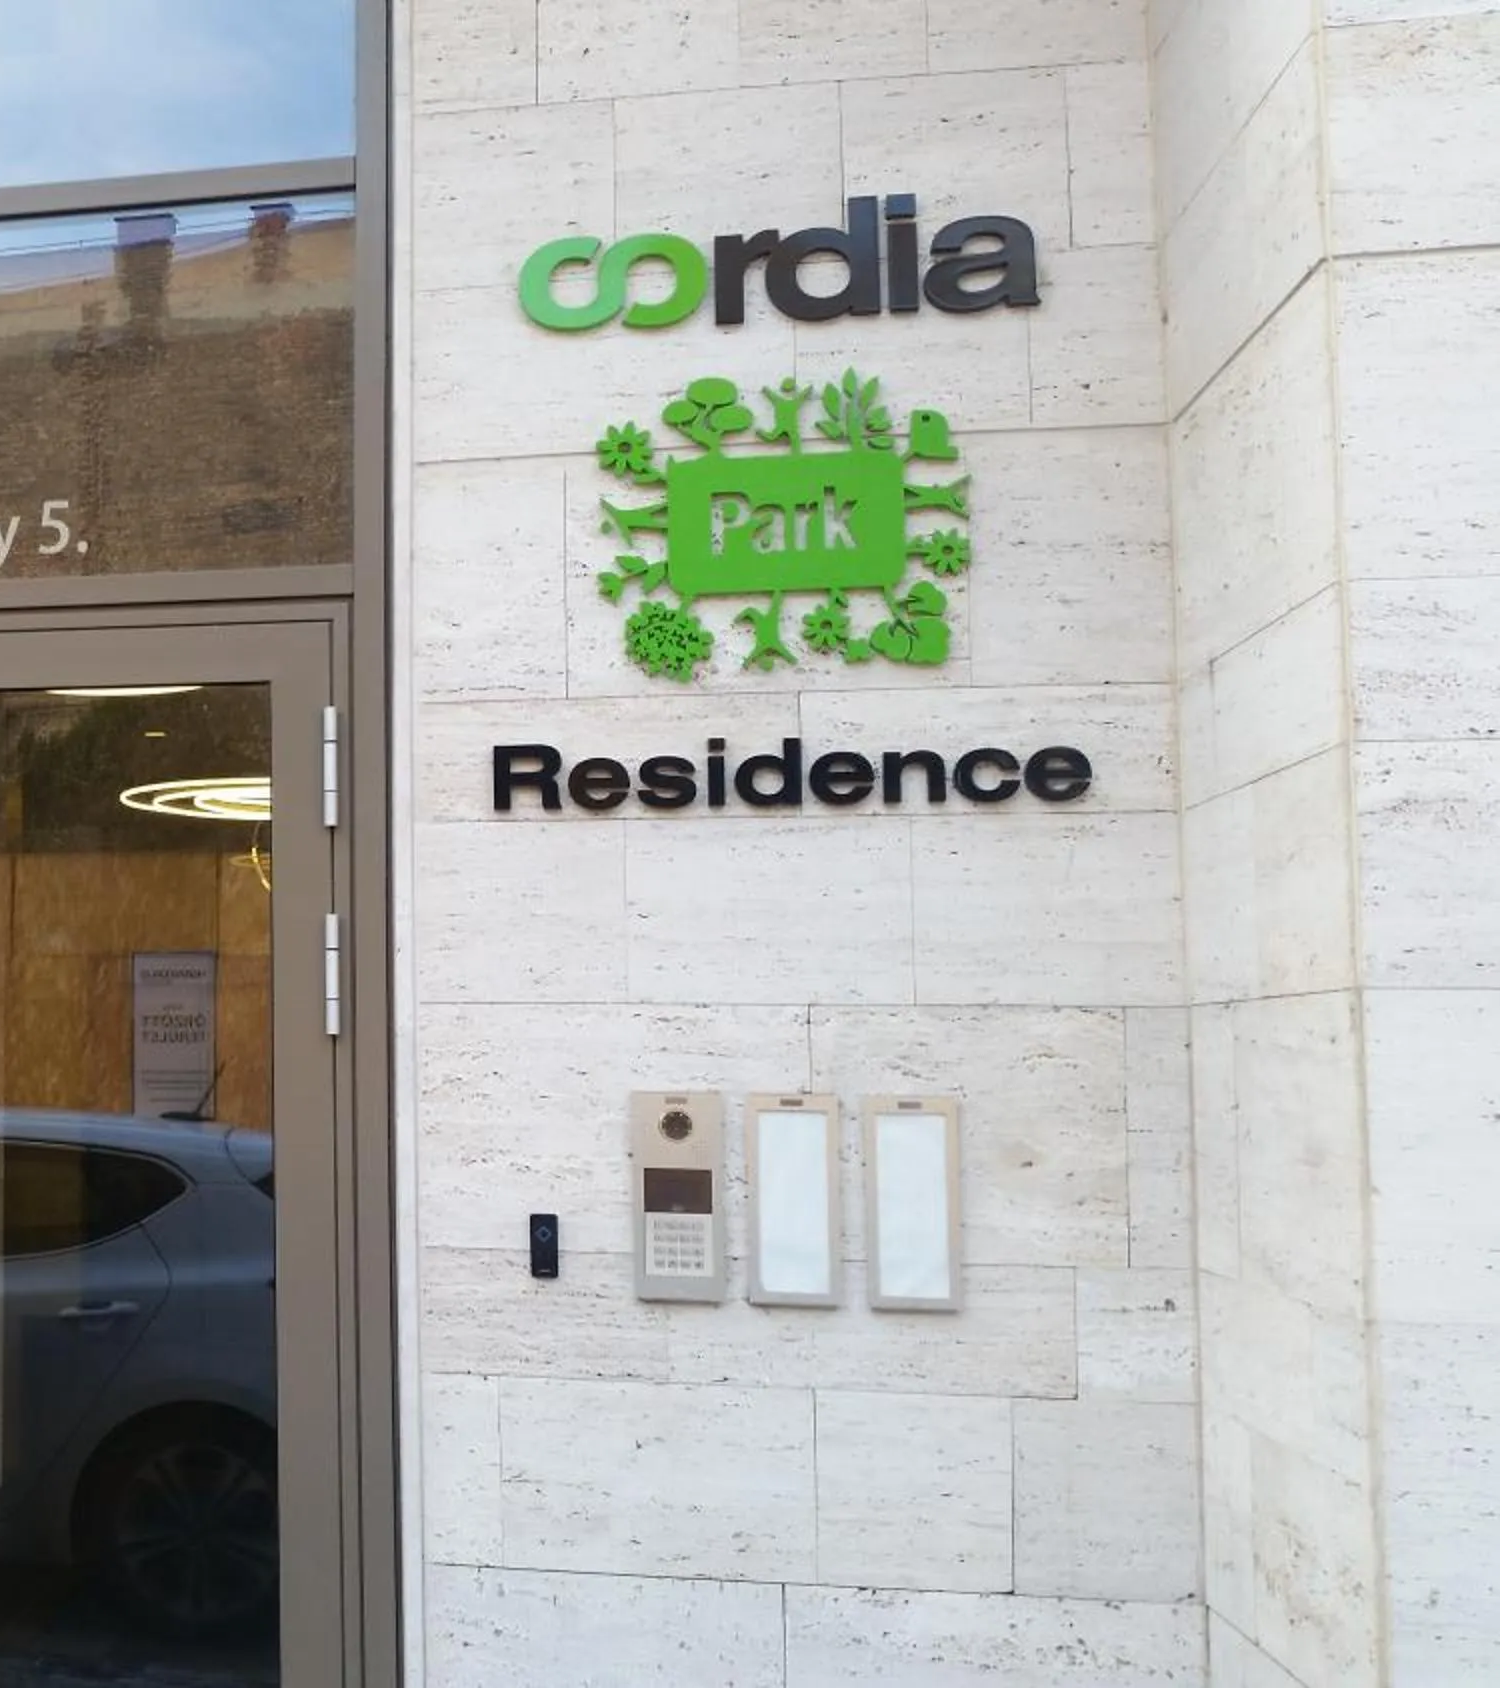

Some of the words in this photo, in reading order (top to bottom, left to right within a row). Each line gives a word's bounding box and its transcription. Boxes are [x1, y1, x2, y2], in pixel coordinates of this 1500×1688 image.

[517, 193, 1041, 332] cordia
[37, 500, 89, 555] 5.
[709, 485, 858, 557] Park
[492, 738, 1093, 812] Residence
